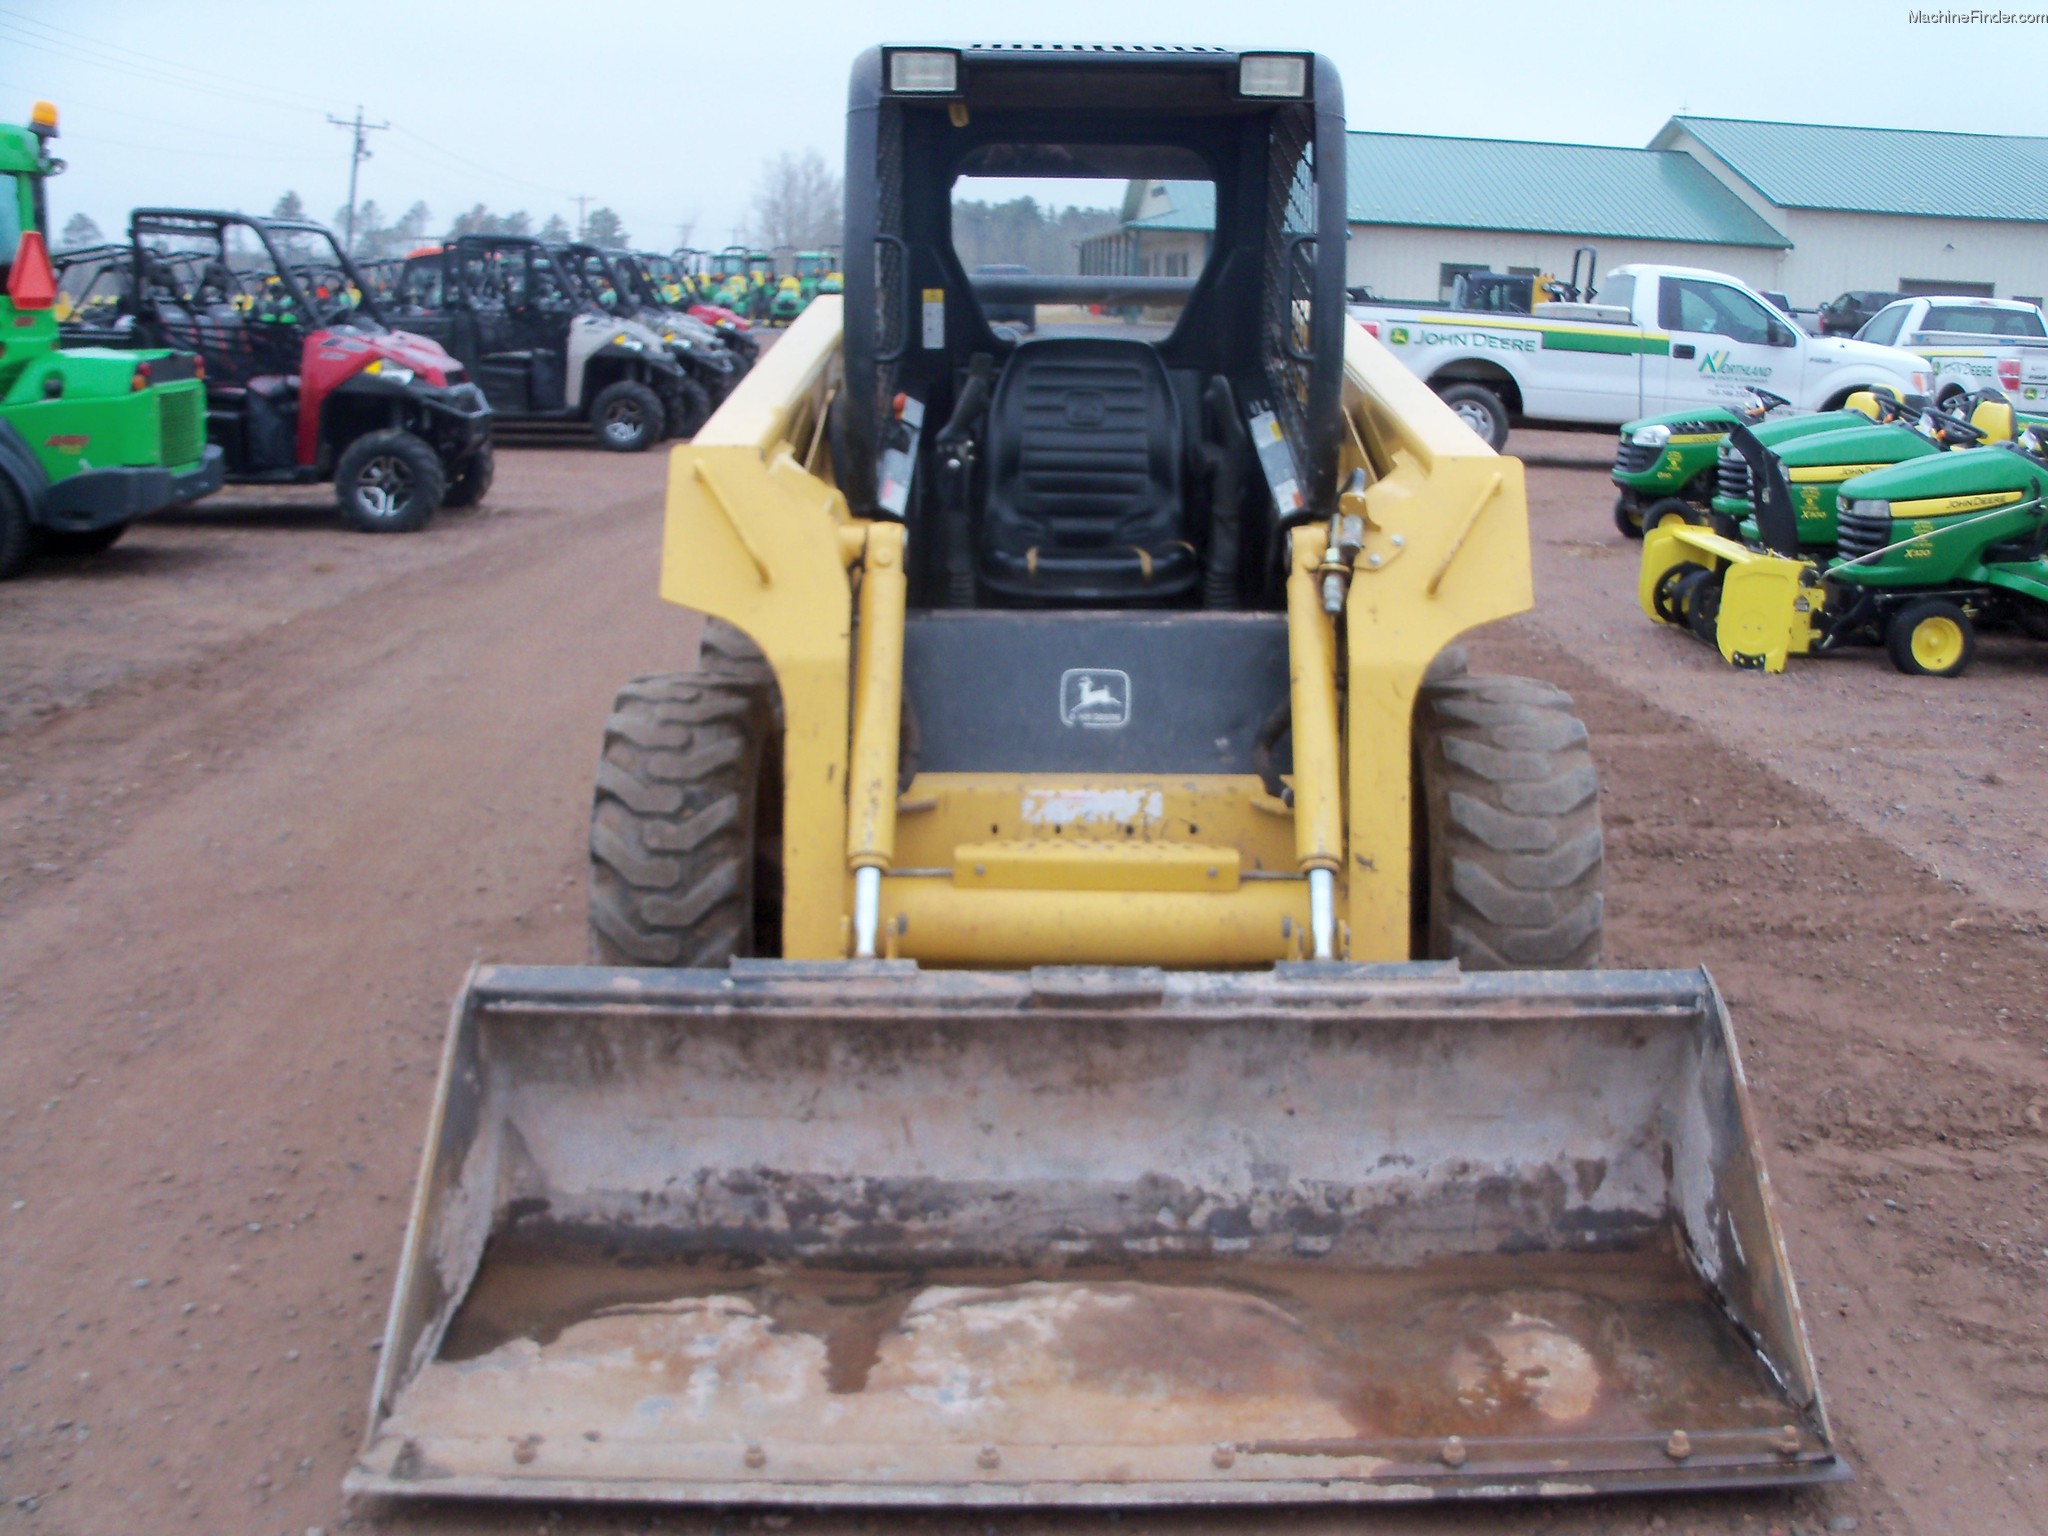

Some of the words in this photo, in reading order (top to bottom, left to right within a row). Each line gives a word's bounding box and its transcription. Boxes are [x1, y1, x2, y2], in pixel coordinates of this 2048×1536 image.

[1413, 329, 1467, 346] JOHN
[1472, 332, 1536, 352] DEERE
[1945, 499, 1974, 510] JOHN
[1974, 495, 2007, 506] DEERE
